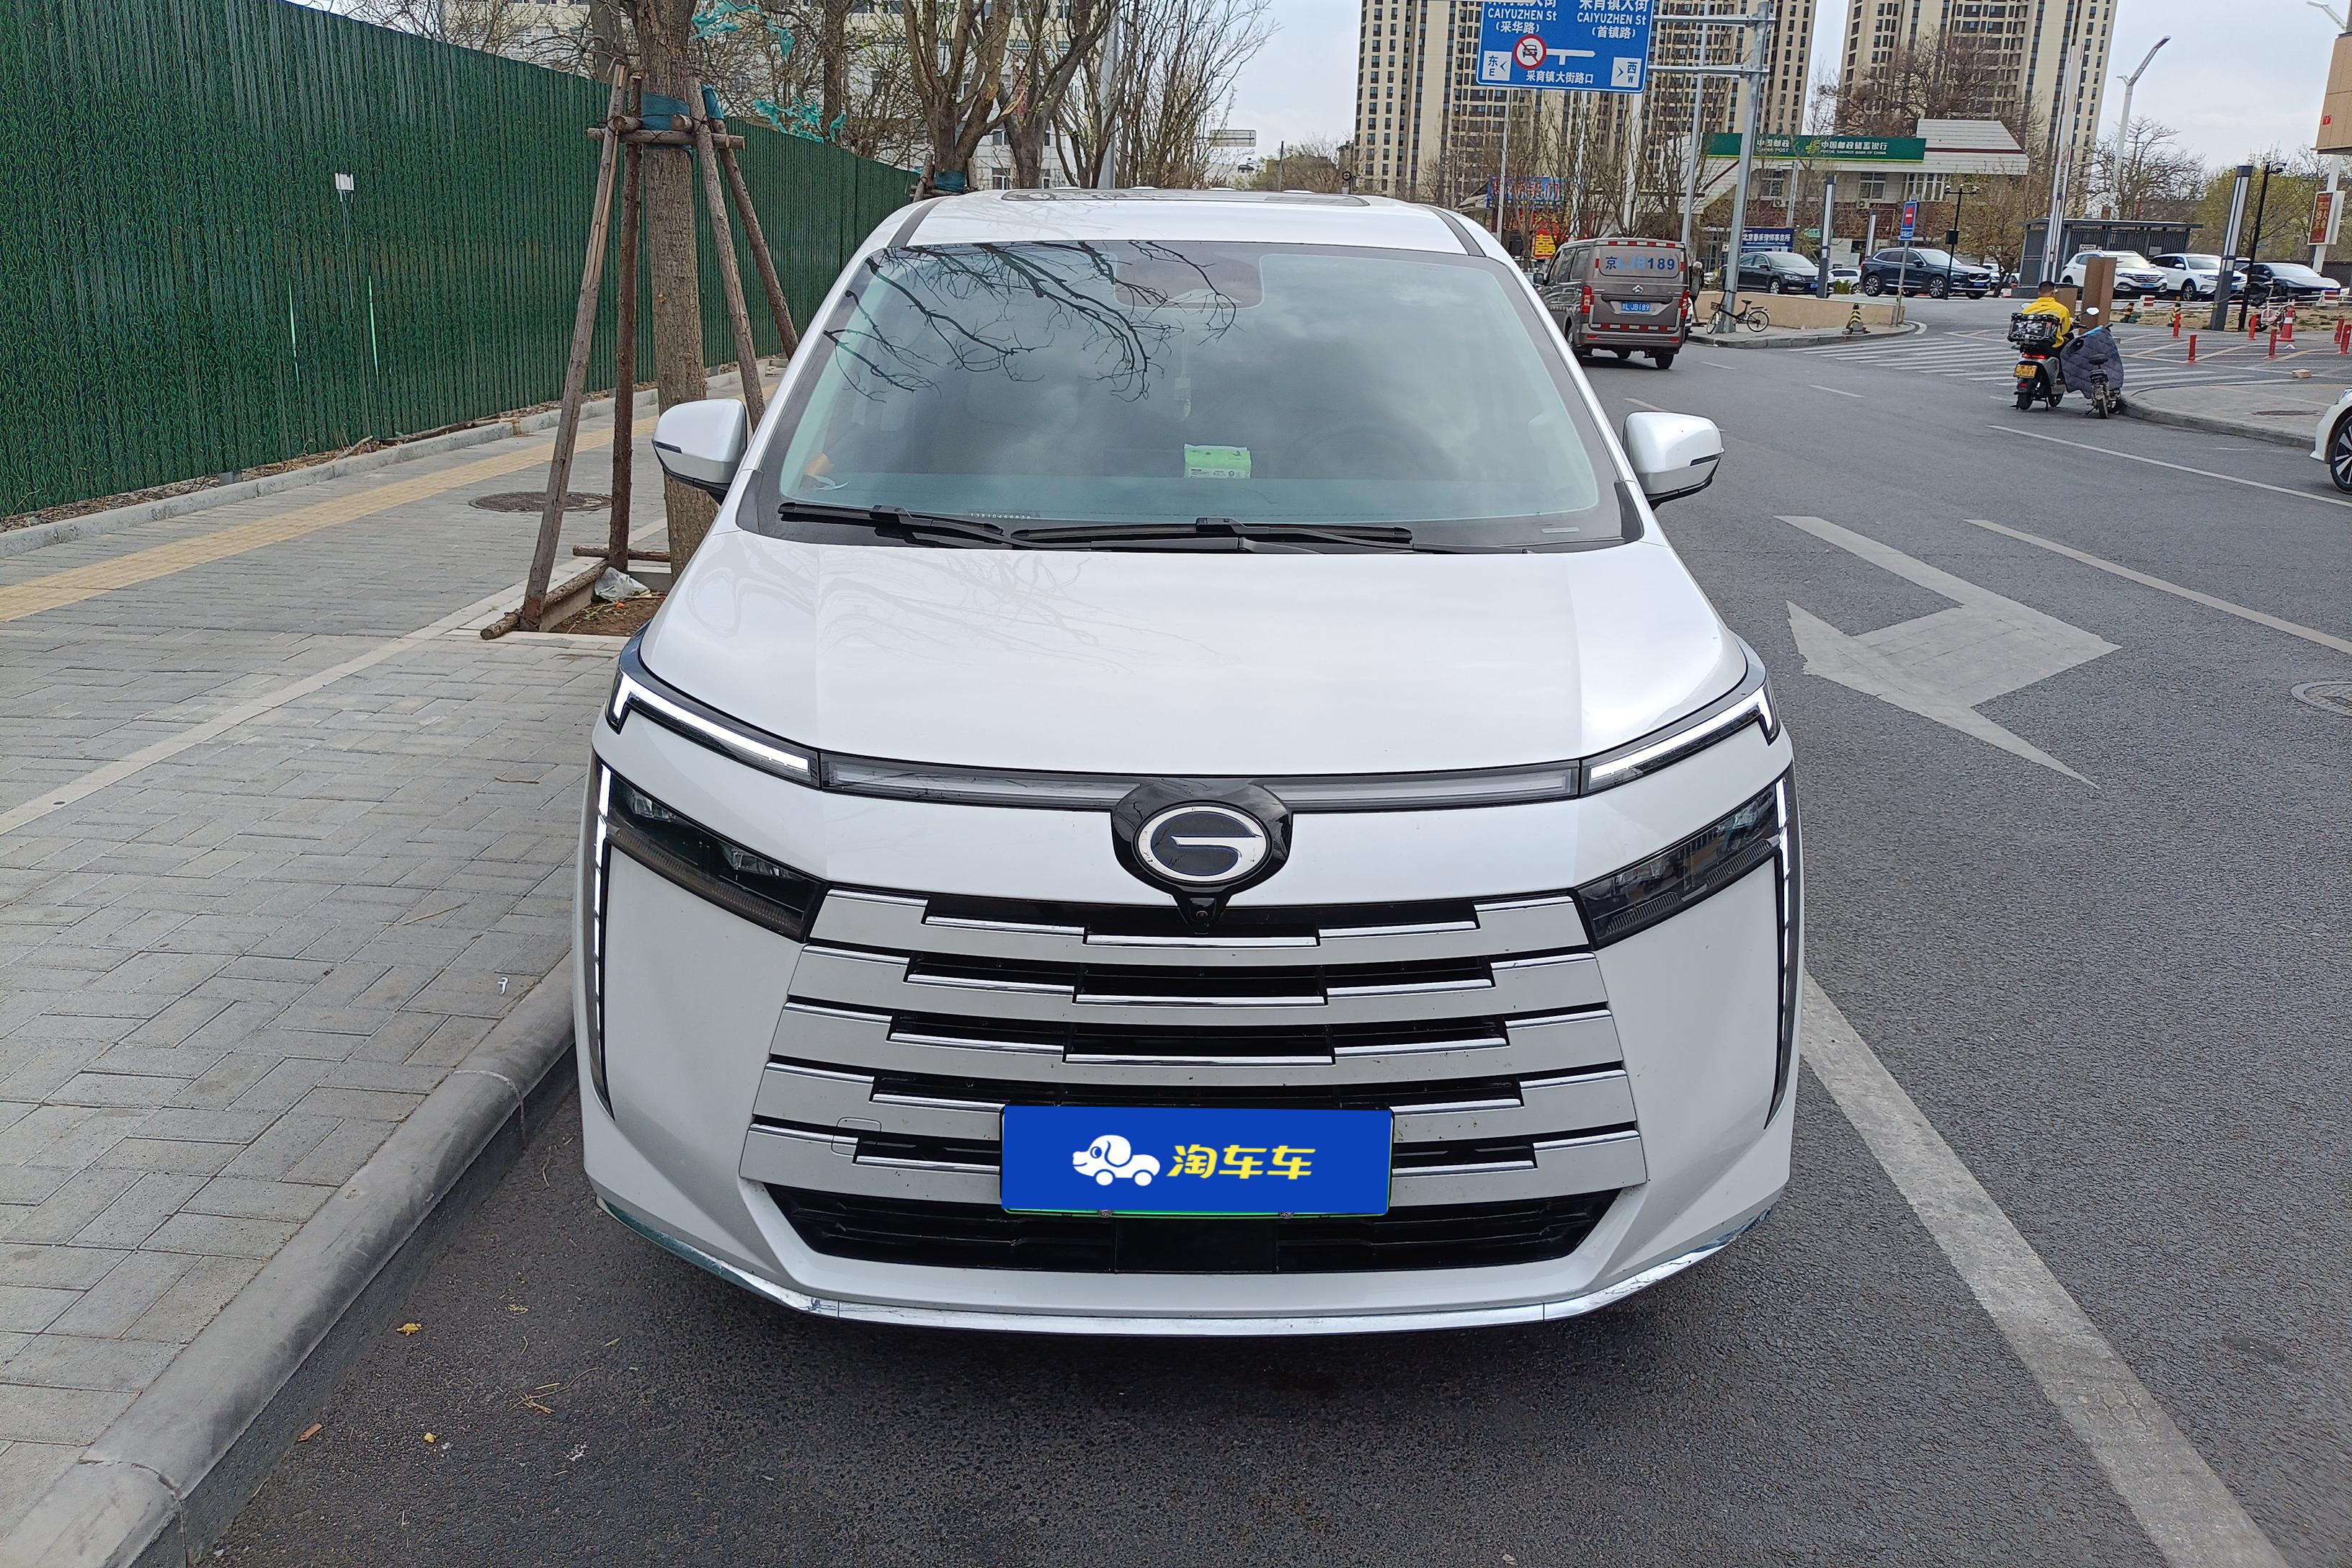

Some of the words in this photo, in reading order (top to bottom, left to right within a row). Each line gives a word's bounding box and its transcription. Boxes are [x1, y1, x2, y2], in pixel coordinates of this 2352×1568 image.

[1488, 8, 1543, 20] CAIYUZHEN
[1546, 11, 1557, 21] St
[1577, 12, 1633, 24] CAIYUZHEN
[1635, 14, 1647, 25] St
[1488, 55, 1498, 66] 东
[1489, 68, 1495, 76] E
[1627, 61, 1638, 73] 西
[1525, 70, 1594, 84] 采育镇大街路口
[1628, 75, 1634, 84] W
[1821, 141, 1888, 151] 中国邮政储蓄银行
